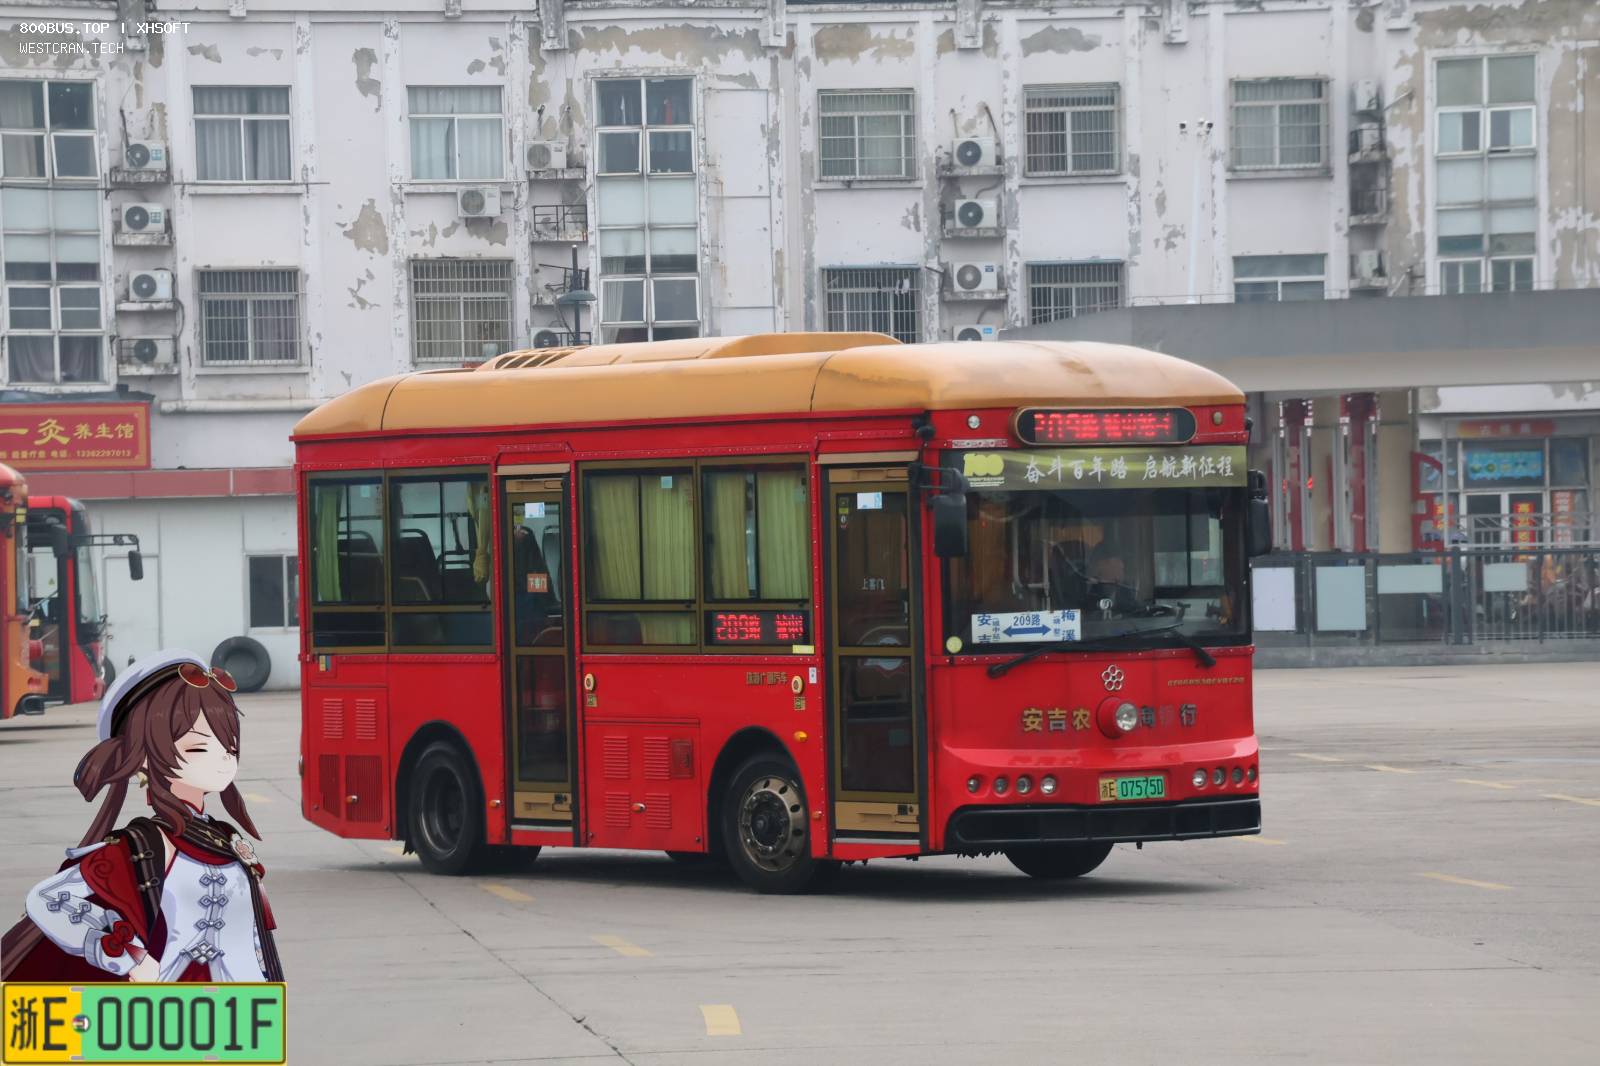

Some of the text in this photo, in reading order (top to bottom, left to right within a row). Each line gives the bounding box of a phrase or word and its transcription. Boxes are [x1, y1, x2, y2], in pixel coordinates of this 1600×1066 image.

[1024, 454, 1234, 485] 奋斗百年路 启航新征程
[1013, 614, 1041, 626] 209路
[1120, 778, 1164, 797] 07575D
